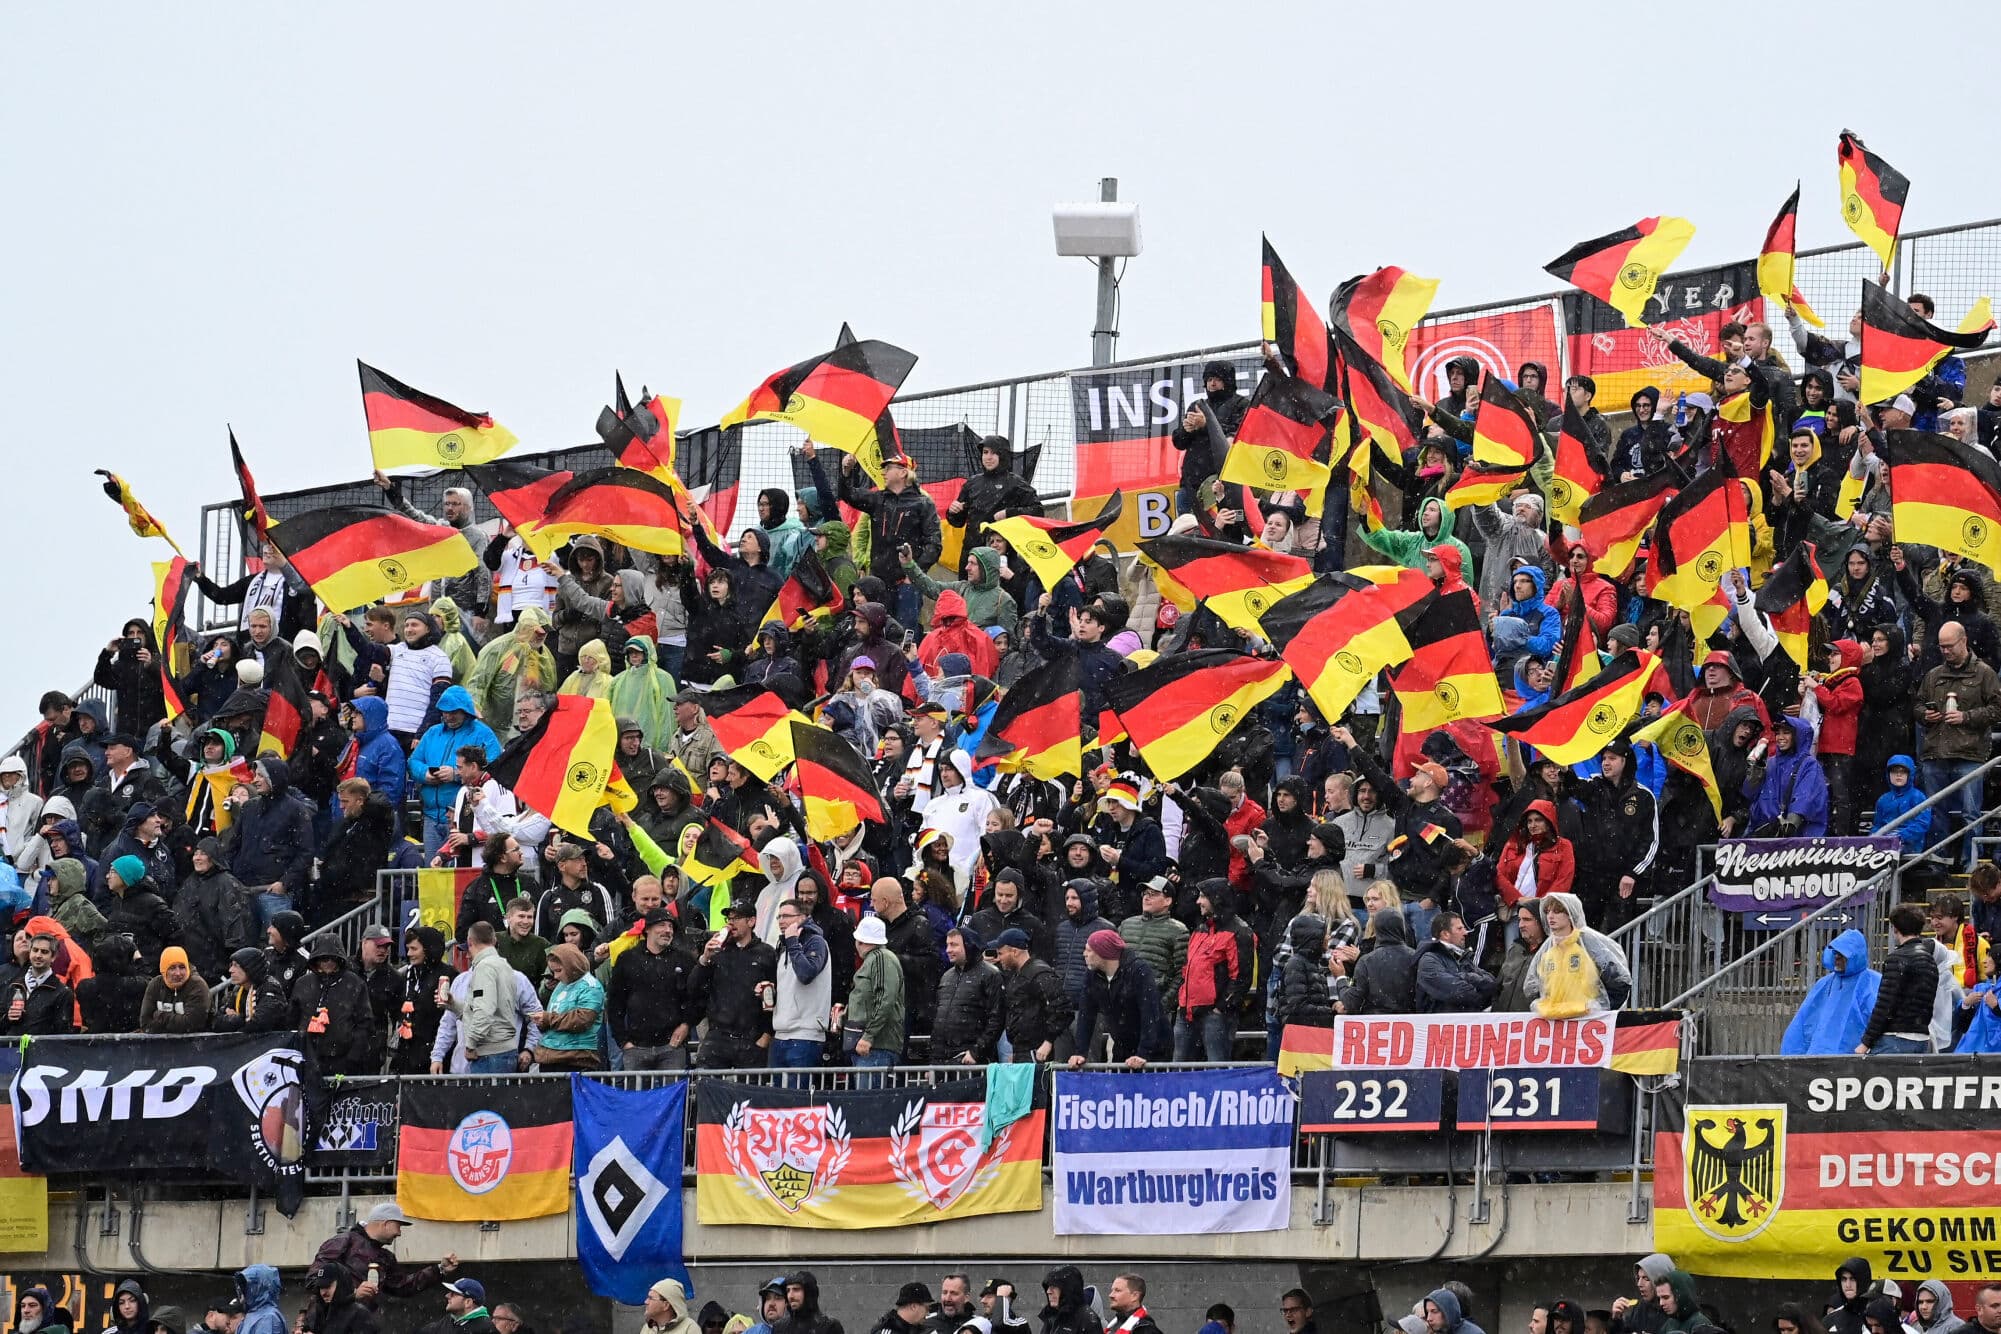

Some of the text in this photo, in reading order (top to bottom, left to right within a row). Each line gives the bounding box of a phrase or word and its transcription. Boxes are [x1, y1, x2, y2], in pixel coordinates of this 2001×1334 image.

[1591, 283, 1754, 356] BYERN
[1715, 838, 1894, 877] Neumünste
[1753, 876, 1784, 901] ON
[1341, 1021, 1414, 1065] RED
[1057, 1088, 1293, 1130] Fischbach/Rhön
[1334, 1080, 1408, 1119] 232
[1490, 1077, 1561, 1117] 231
[1807, 1076, 2001, 1112] SPORTFR
[934, 1106, 981, 1125] HFC
[1067, 1167, 1277, 1207] Wartburgkreis
[1837, 1217, 1996, 1243] GEKOMM
[1883, 1250, 2001, 1273] ZU SIE
